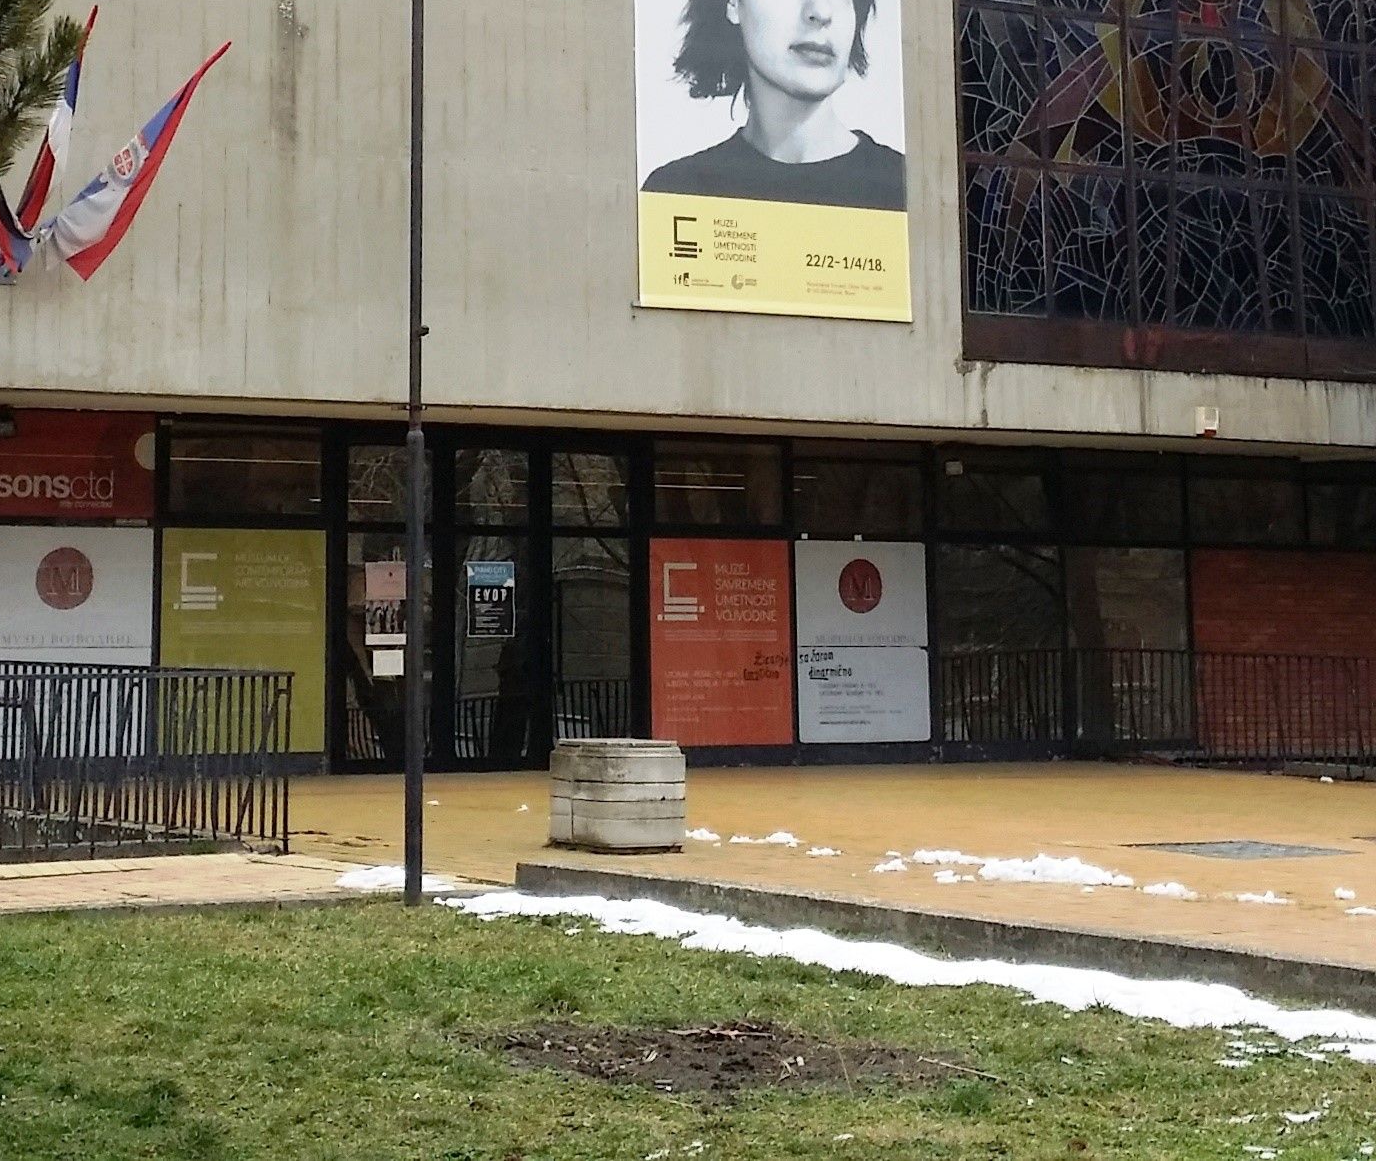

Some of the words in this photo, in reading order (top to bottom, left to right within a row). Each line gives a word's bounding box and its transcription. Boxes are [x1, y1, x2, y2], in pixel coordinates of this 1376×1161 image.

[713, 218, 738, 228] MUZEJ
[713, 229, 758, 241] SAVREMENE
[713, 241, 757, 252] UMETNOSTI
[713, 252, 758, 263] VOJVODINE
[714, 563, 750, 575] MUZEJ
[714, 578, 777, 591] SAVREMENE
[714, 593, 777, 607] UMETNOSTI
[714, 608, 777, 622] VOJVODINE
